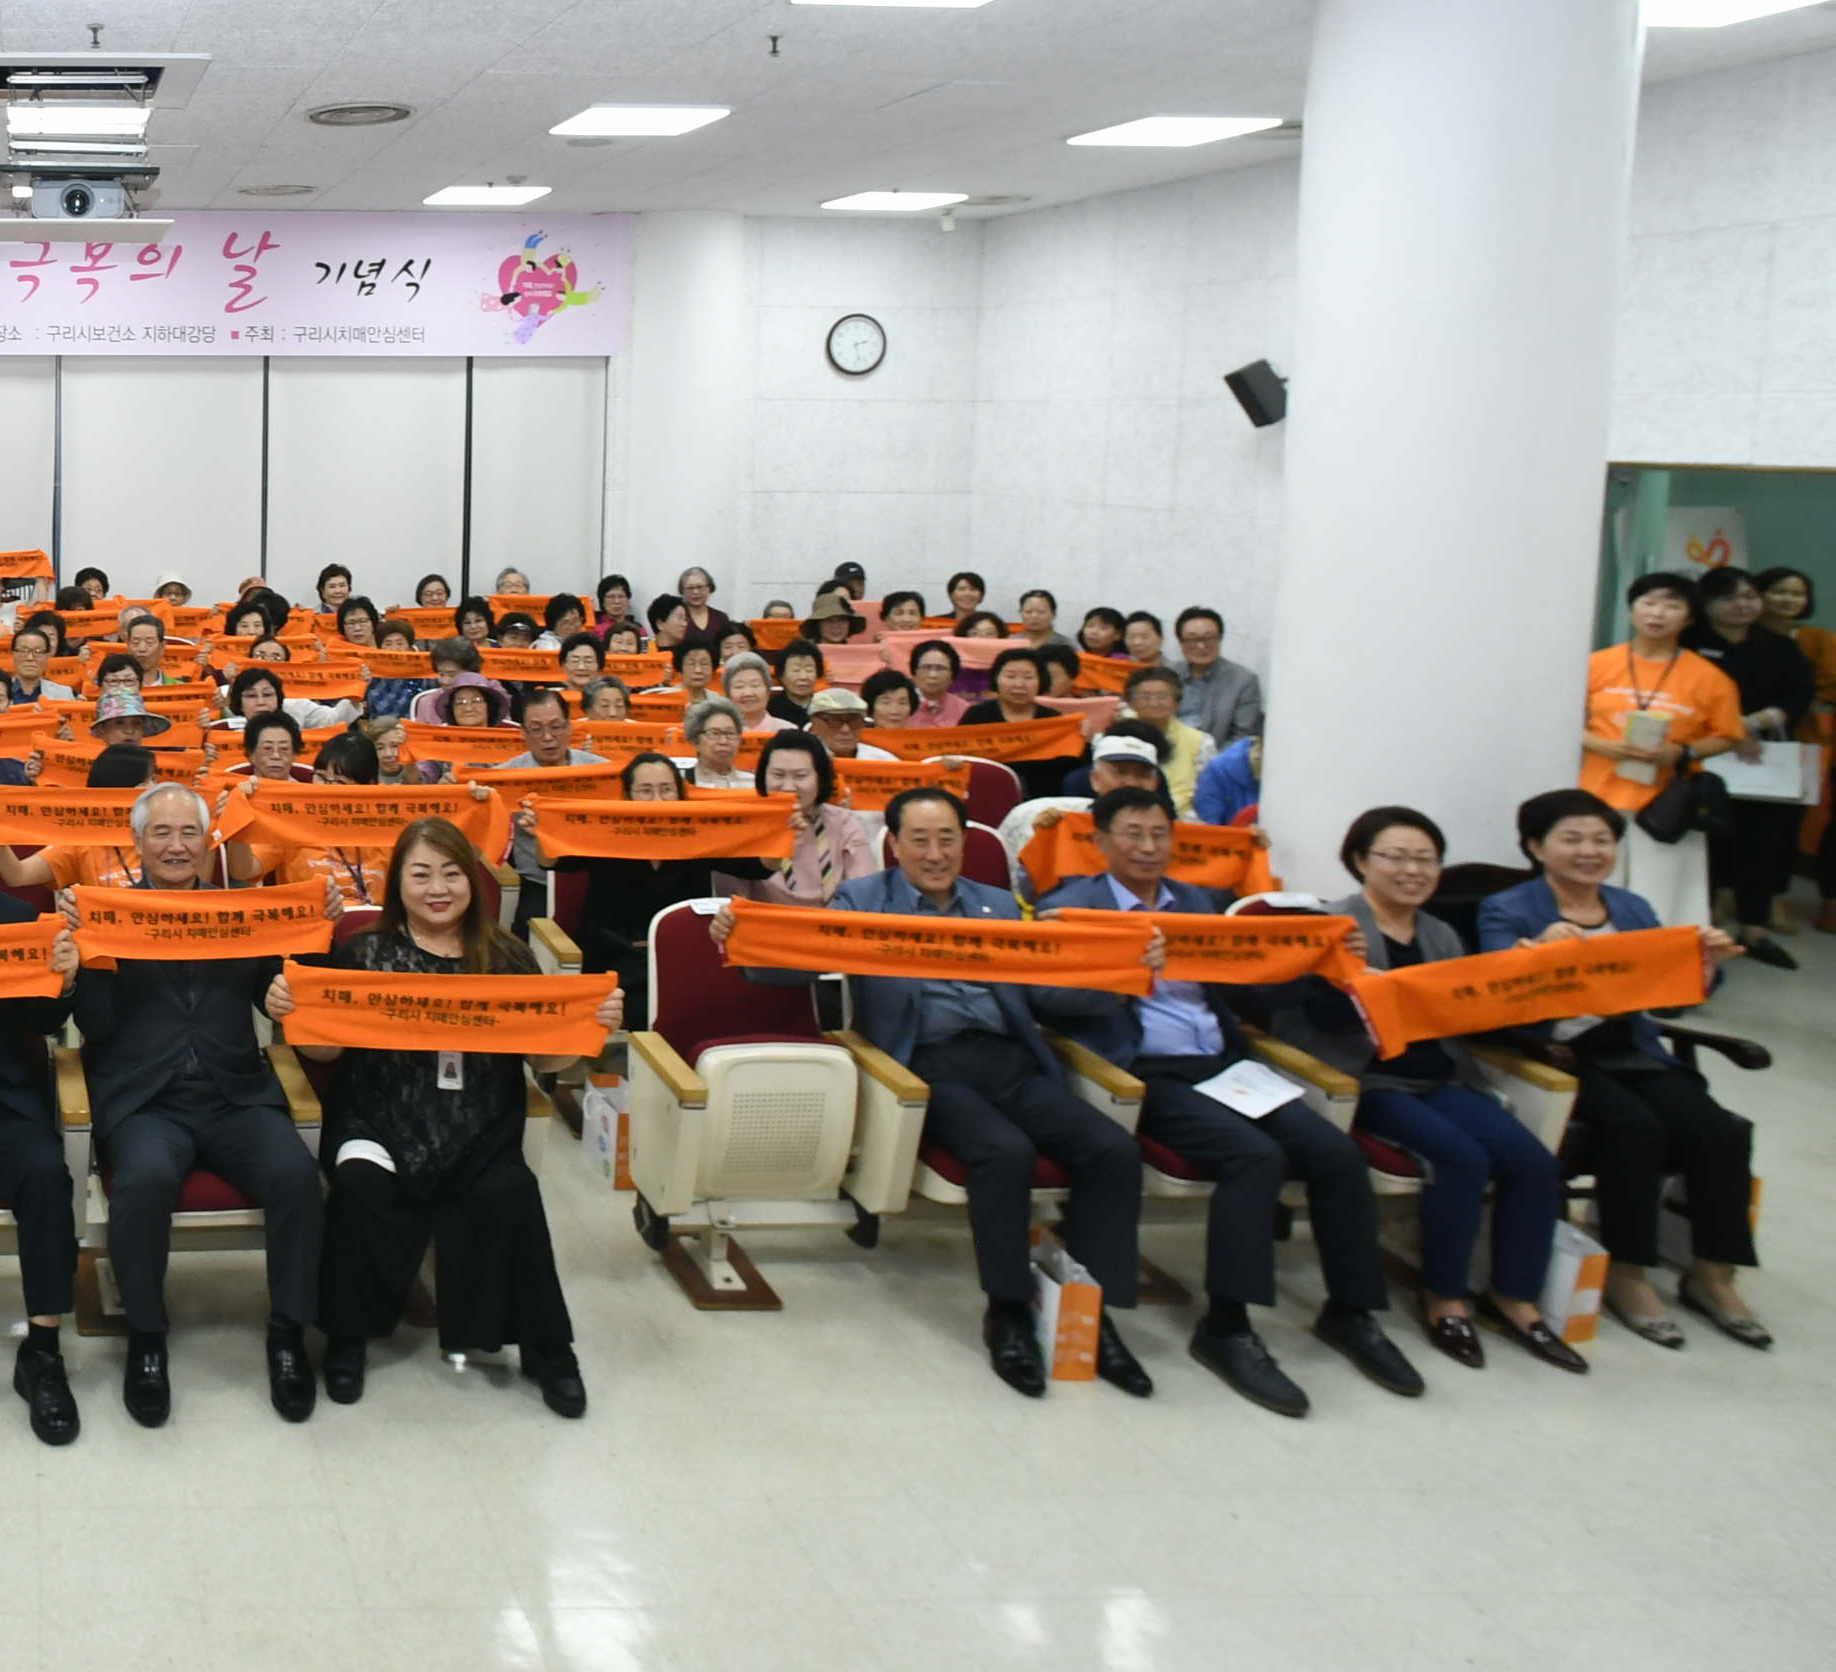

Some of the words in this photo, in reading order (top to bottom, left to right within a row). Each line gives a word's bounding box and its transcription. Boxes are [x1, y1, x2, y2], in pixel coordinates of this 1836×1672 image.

[222, 230, 281, 314] 날
[314, 257, 432, 302] 기념식
[46, 325, 136, 343] 구리시보건소
[141, 325, 217, 343] 지하대강당
[244, 325, 275, 343] 주최
[293, 325, 425, 344] 구리시치매안심센터
[40, 805, 107, 818] 안심하세요!
[304, 803, 371, 816] 안심하세요!
[375, 802, 400, 815] 함께
[405, 801, 459, 814] 극복해요!
[87, 818, 131, 828] 치매안심센
[130, 910, 211, 925] 안심하세요!
[216, 910, 245, 924] 함께
[252, 904, 315, 922] 극복해요!
[367, 991, 453, 1010] 안심하세요!
[459, 999, 489, 1012] 함께
[496, 999, 567, 1016] 극복해요!
